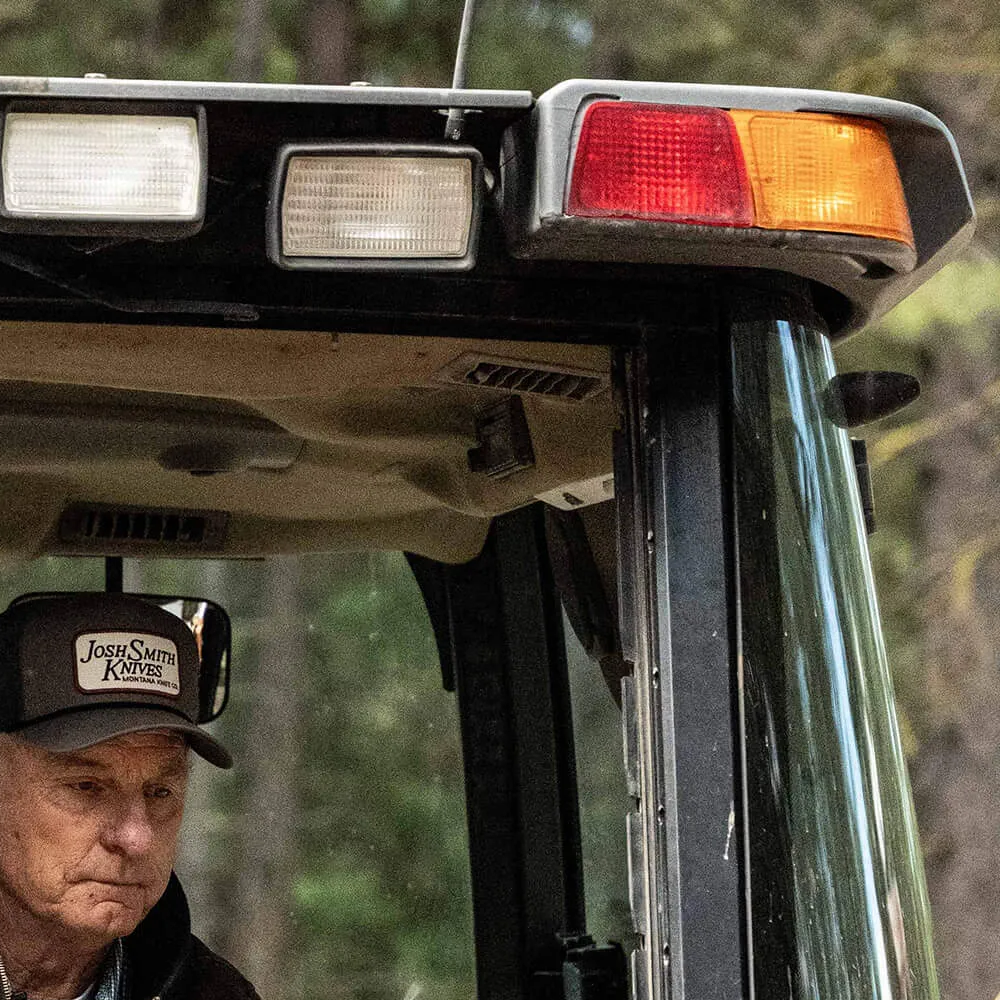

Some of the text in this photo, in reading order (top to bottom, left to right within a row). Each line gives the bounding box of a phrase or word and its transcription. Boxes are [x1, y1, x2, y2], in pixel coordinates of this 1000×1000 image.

[80, 639, 175, 666] JOSH SMITH
[101, 659, 163, 682] KNIVES
[122, 676, 155, 684] MONTANA
